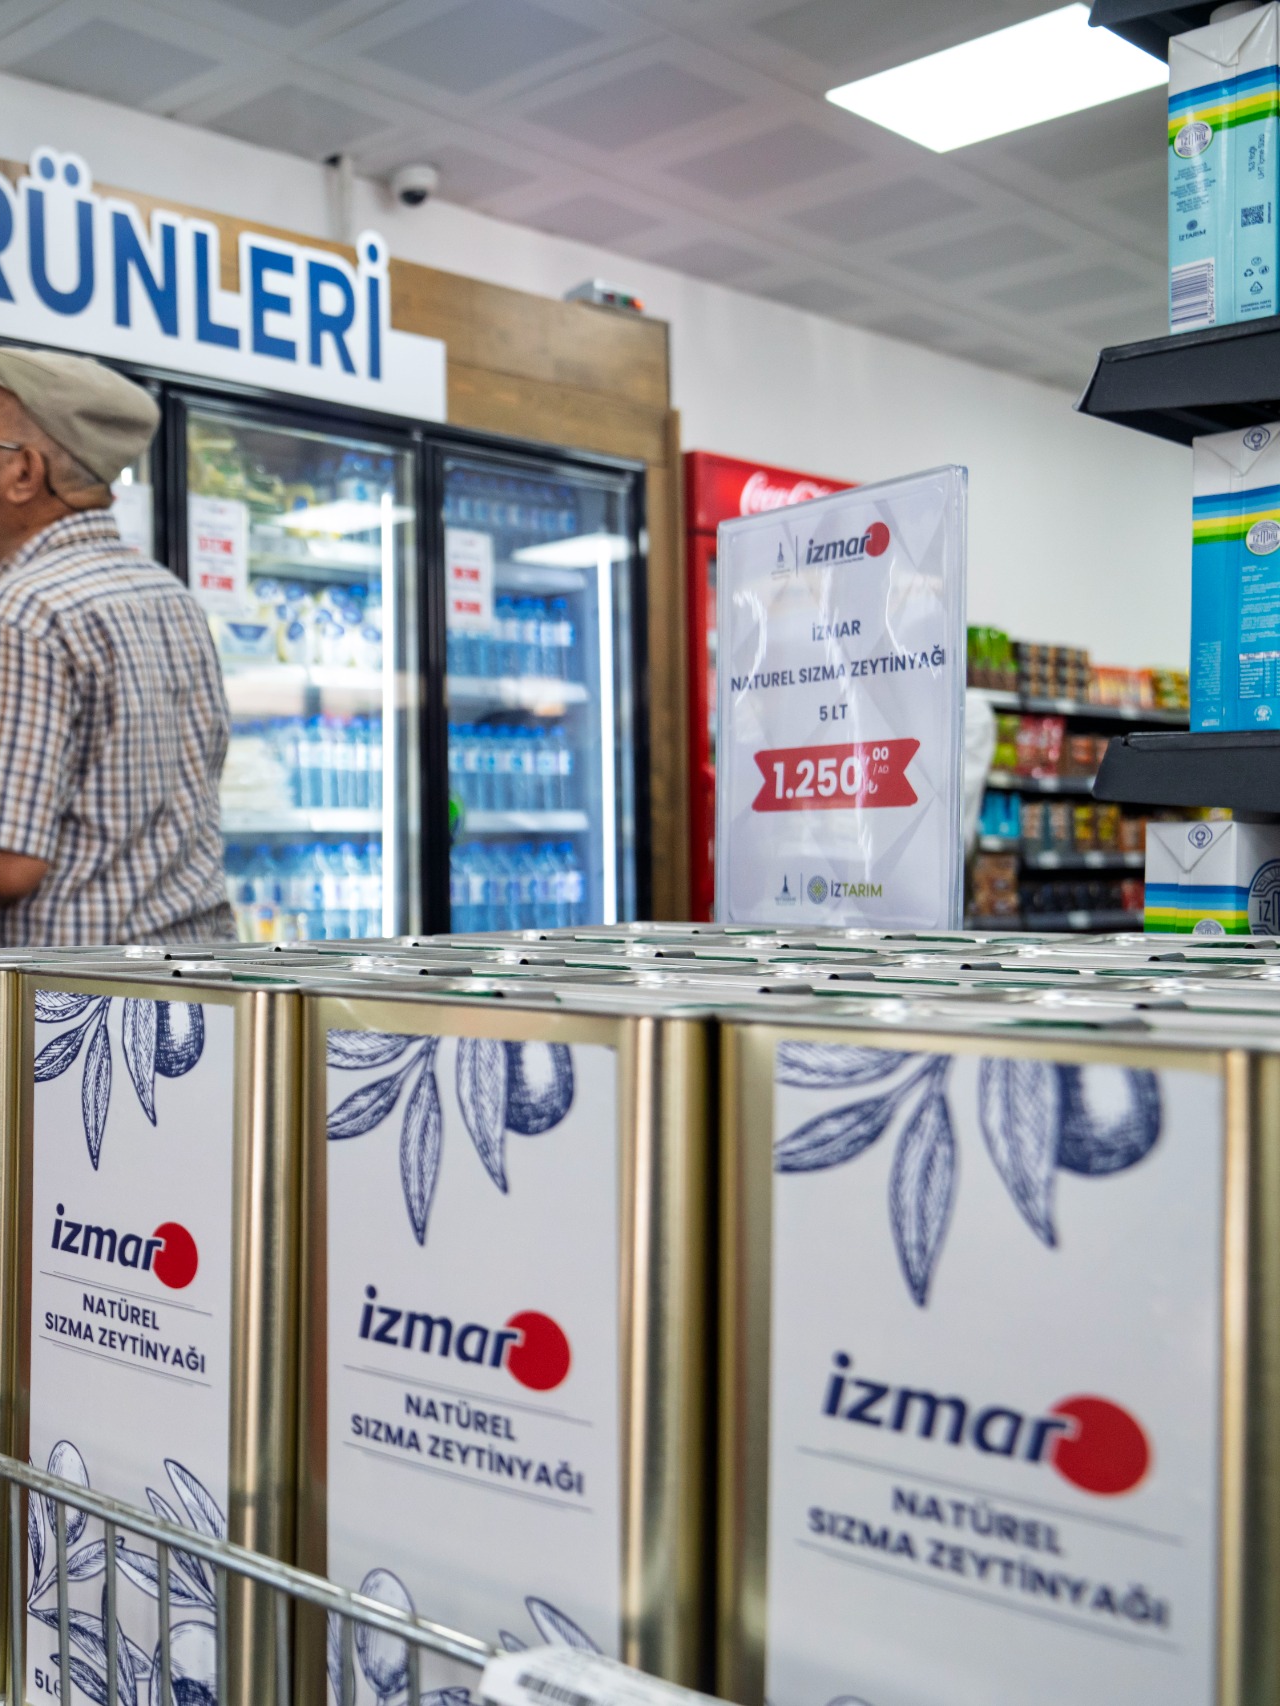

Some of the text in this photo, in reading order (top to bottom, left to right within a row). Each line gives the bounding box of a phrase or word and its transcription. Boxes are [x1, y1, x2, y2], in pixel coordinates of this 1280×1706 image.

[806, 533, 871, 565] izmar
[812, 619, 861, 642] İZMAR
[731, 644, 945, 692] NATUREL SIZMA ZEYTİNYAĞI
[819, 704, 848, 721] 5 LT
[51, 1203, 162, 1271] izmar
[45, 1311, 206, 1373] SIZMA ZEYTİNYAĞI
[83, 1293, 160, 1331] NATÜREL
[358, 1284, 518, 1368] izmar
[405, 1393, 516, 1442] NATÜREL
[823, 1351, 1067, 1463] izmar
[351, 1413, 585, 1495] SIZMA ZEYTİNYAĞI
[891, 1485, 1065, 1557] NATÜREL
[807, 1506, 1170, 1628] SIZMA ZEYTİNYAĞI
